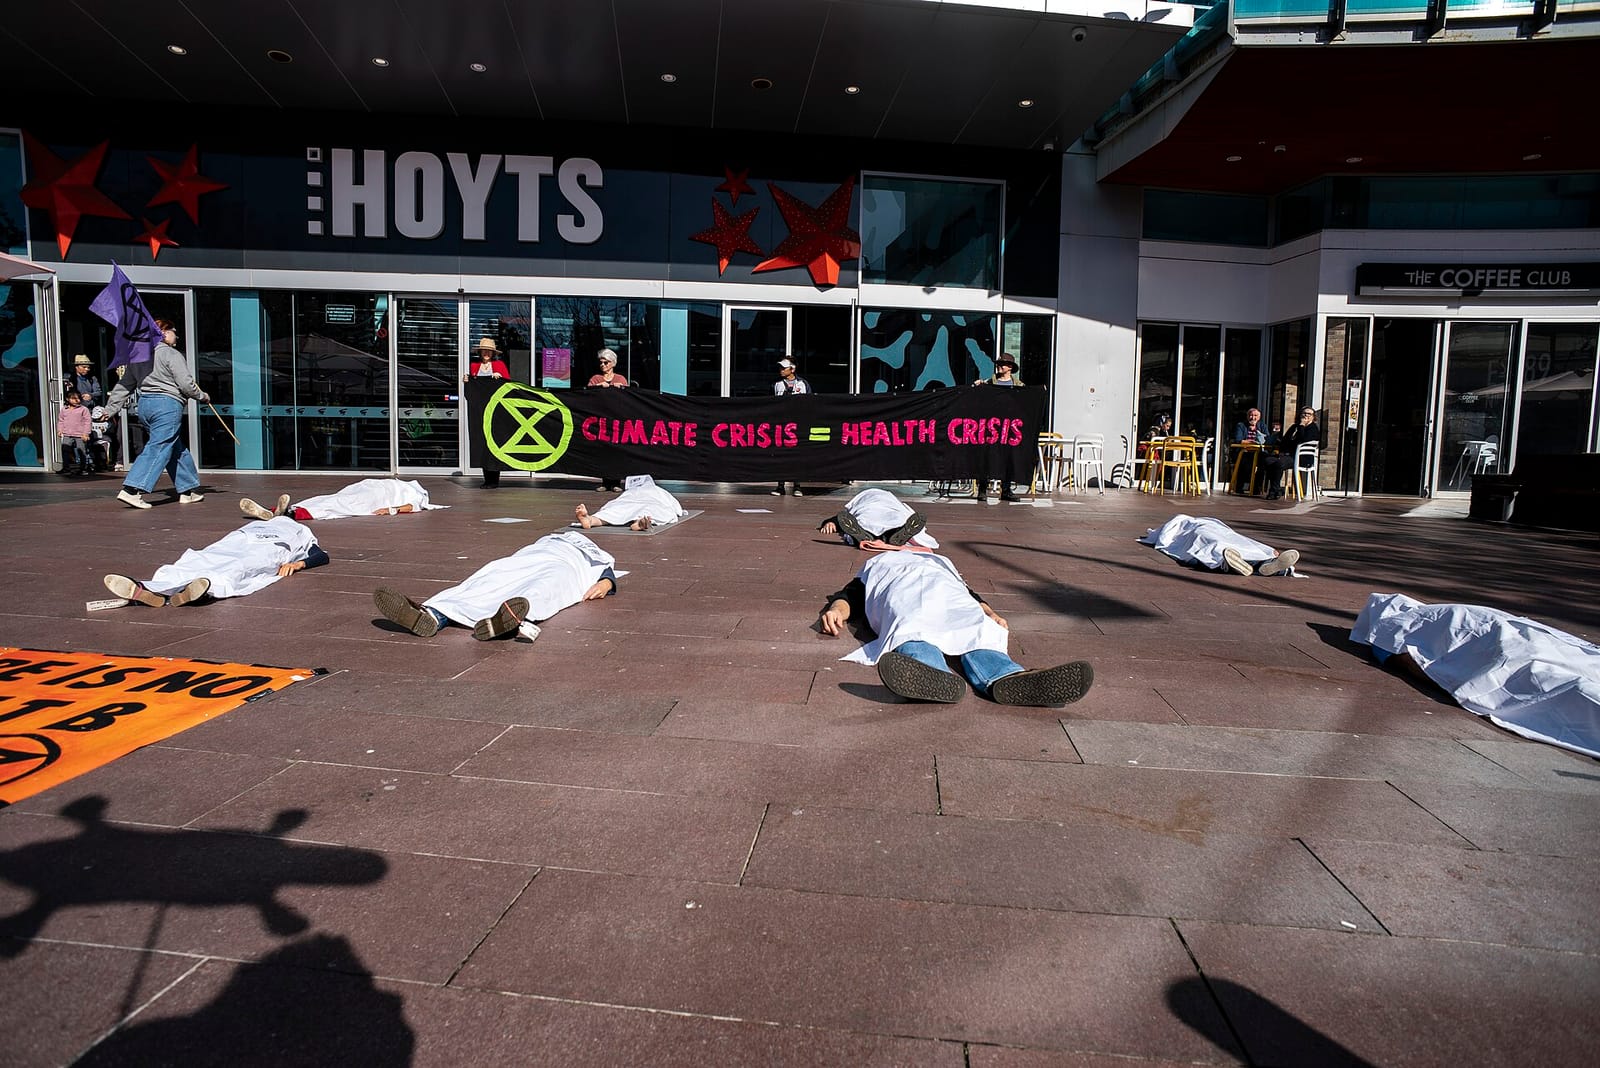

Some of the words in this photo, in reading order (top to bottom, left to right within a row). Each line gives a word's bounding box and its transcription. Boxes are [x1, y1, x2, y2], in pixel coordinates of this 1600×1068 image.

[331, 148, 603, 244] HOYTS
[1404, 270, 1435, 285] THE
[1439, 269, 1521, 287] COFFEE
[1526, 271, 1571, 285] CLUB
[582, 416, 697, 447] CLIMATE
[711, 422, 798, 448] CRISIS
[809, 427, 831, 441] =
[841, 419, 936, 446] HEALTH
[947, 417, 1023, 446] CRISIS
[37, 664, 156, 689] IS
[124, 670, 272, 698] NO
[0, 695, 76, 722] T
[37, 702, 147, 732] B
